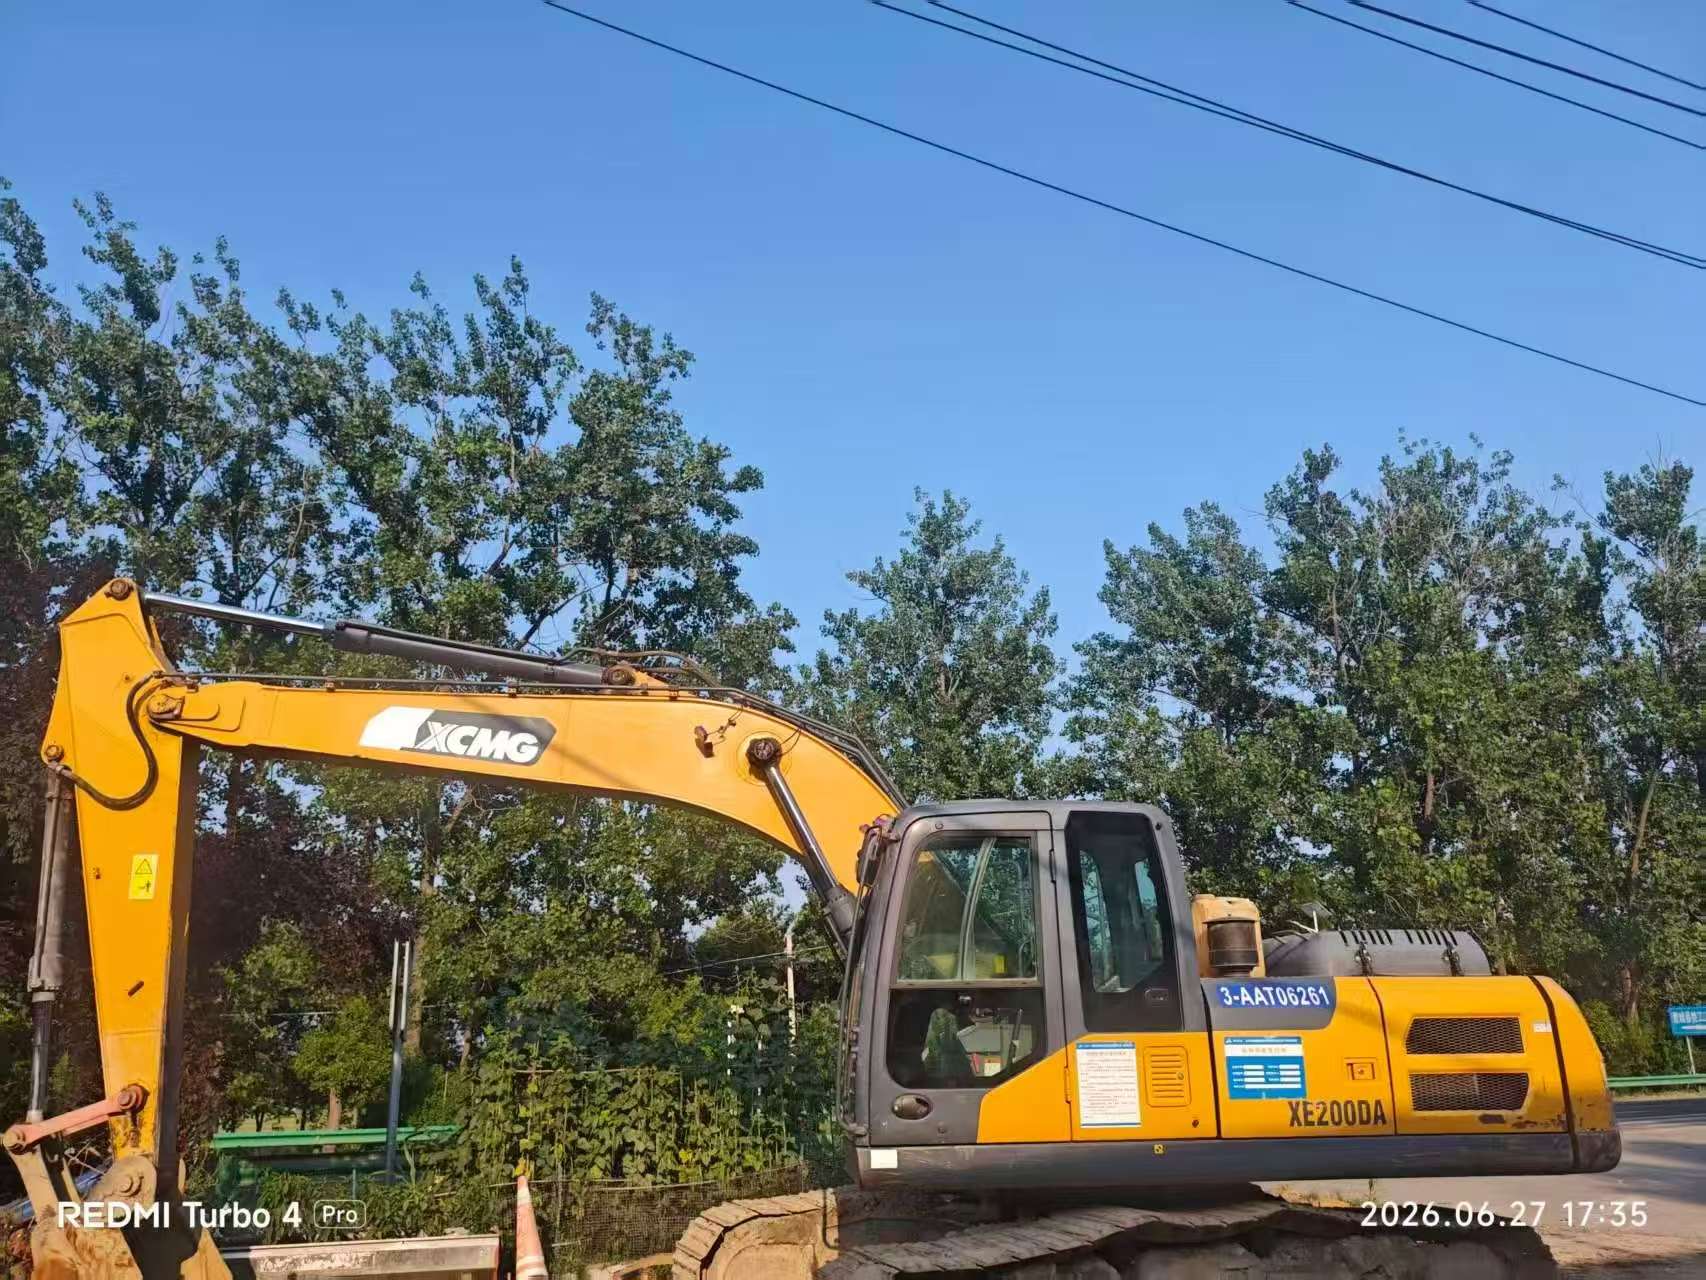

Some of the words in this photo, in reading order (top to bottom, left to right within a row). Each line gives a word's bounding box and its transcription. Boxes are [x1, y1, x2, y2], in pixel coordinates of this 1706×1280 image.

[416, 721, 539, 763] XCMG
[1220, 986, 1330, 1006] 3-AAT06261
[1288, 1100, 1386, 1126] XE200DA
